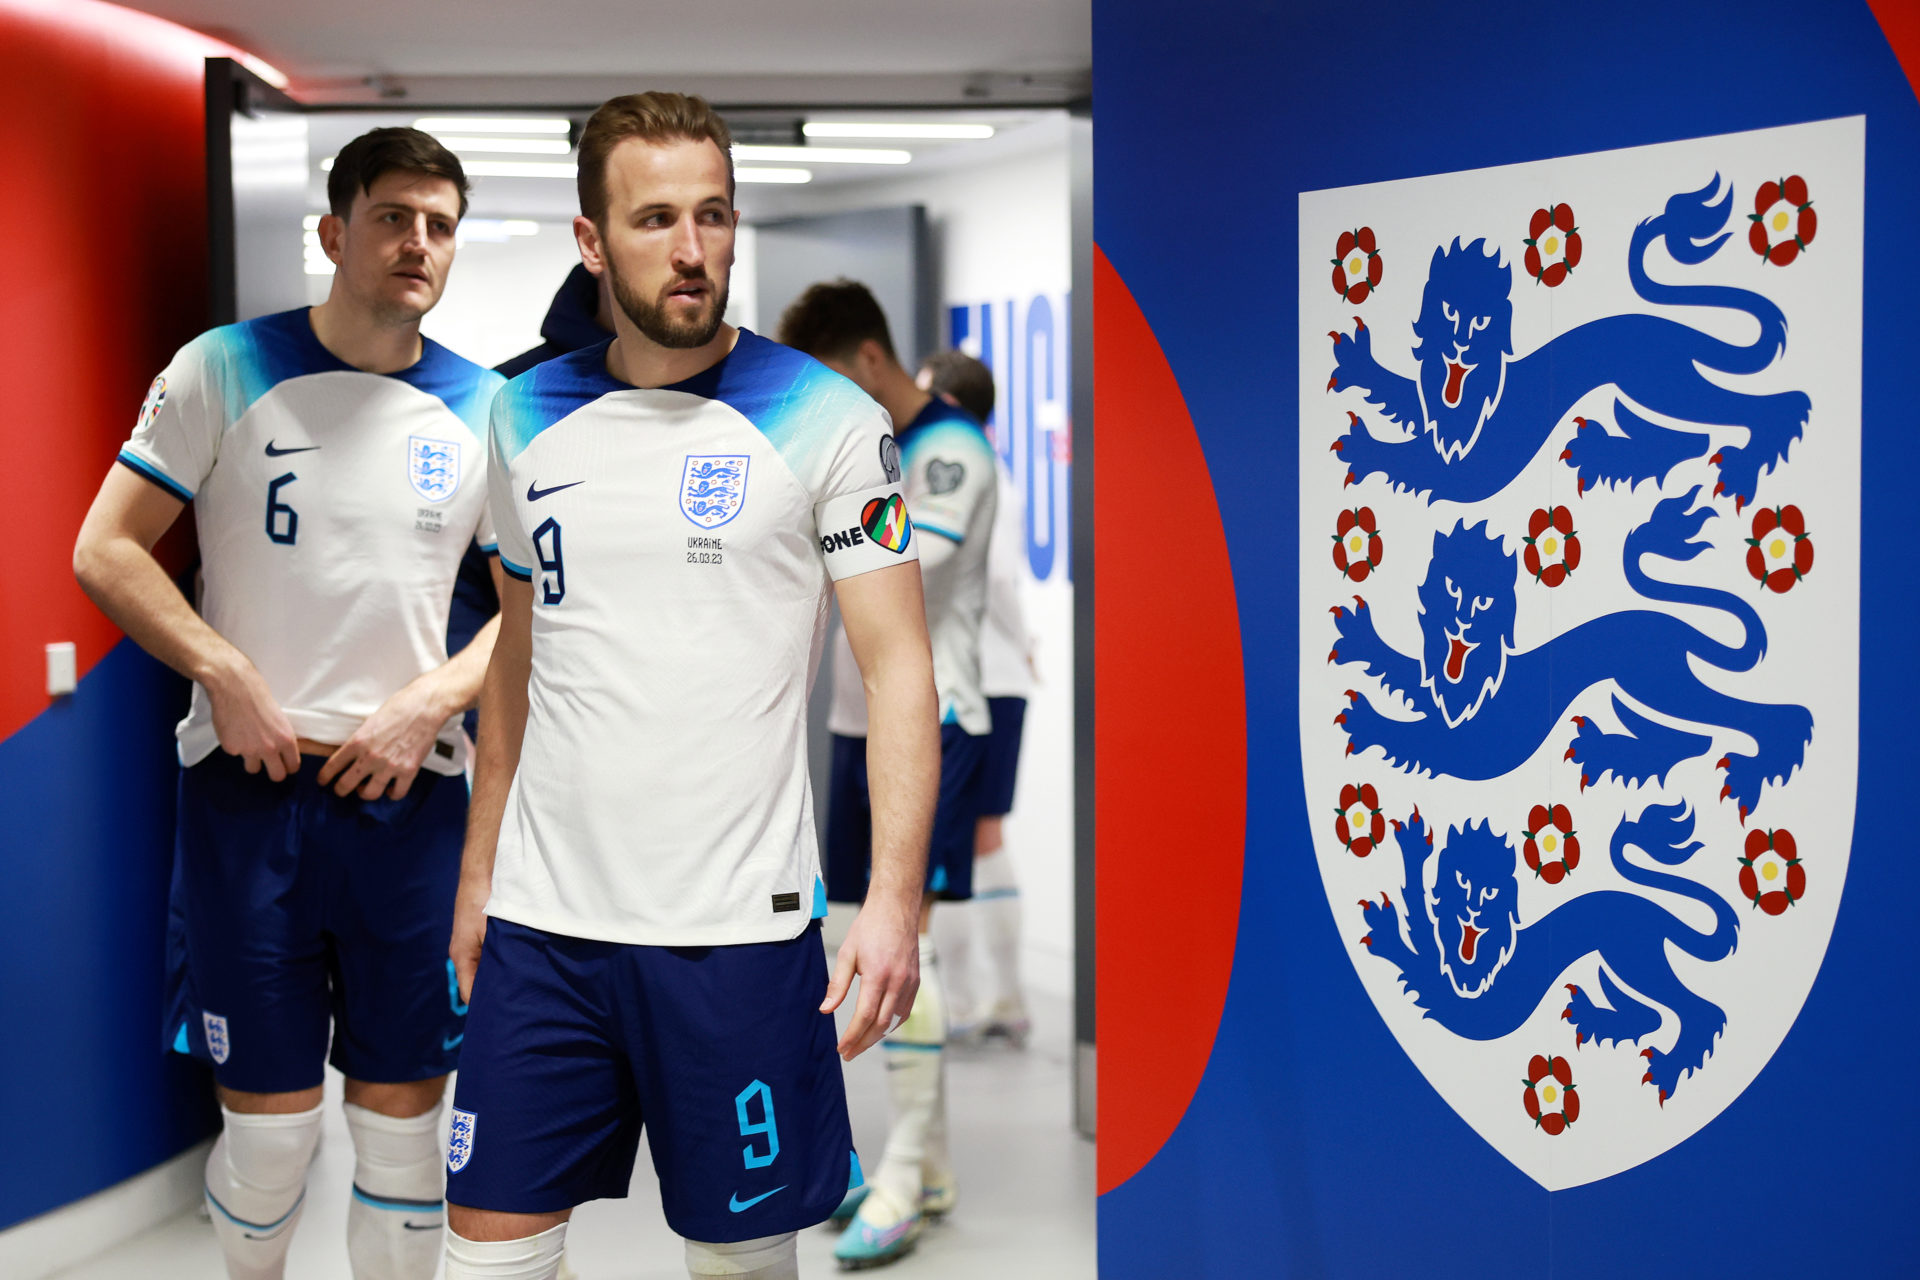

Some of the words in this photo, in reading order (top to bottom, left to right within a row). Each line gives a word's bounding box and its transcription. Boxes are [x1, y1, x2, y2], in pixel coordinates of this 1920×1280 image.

[265, 471, 299, 546] 6
[885, 505, 901, 546] 1
[532, 516, 566, 605] 9
[687, 551, 723, 565] 26.03.23
[734, 1078, 780, 1170] 9
